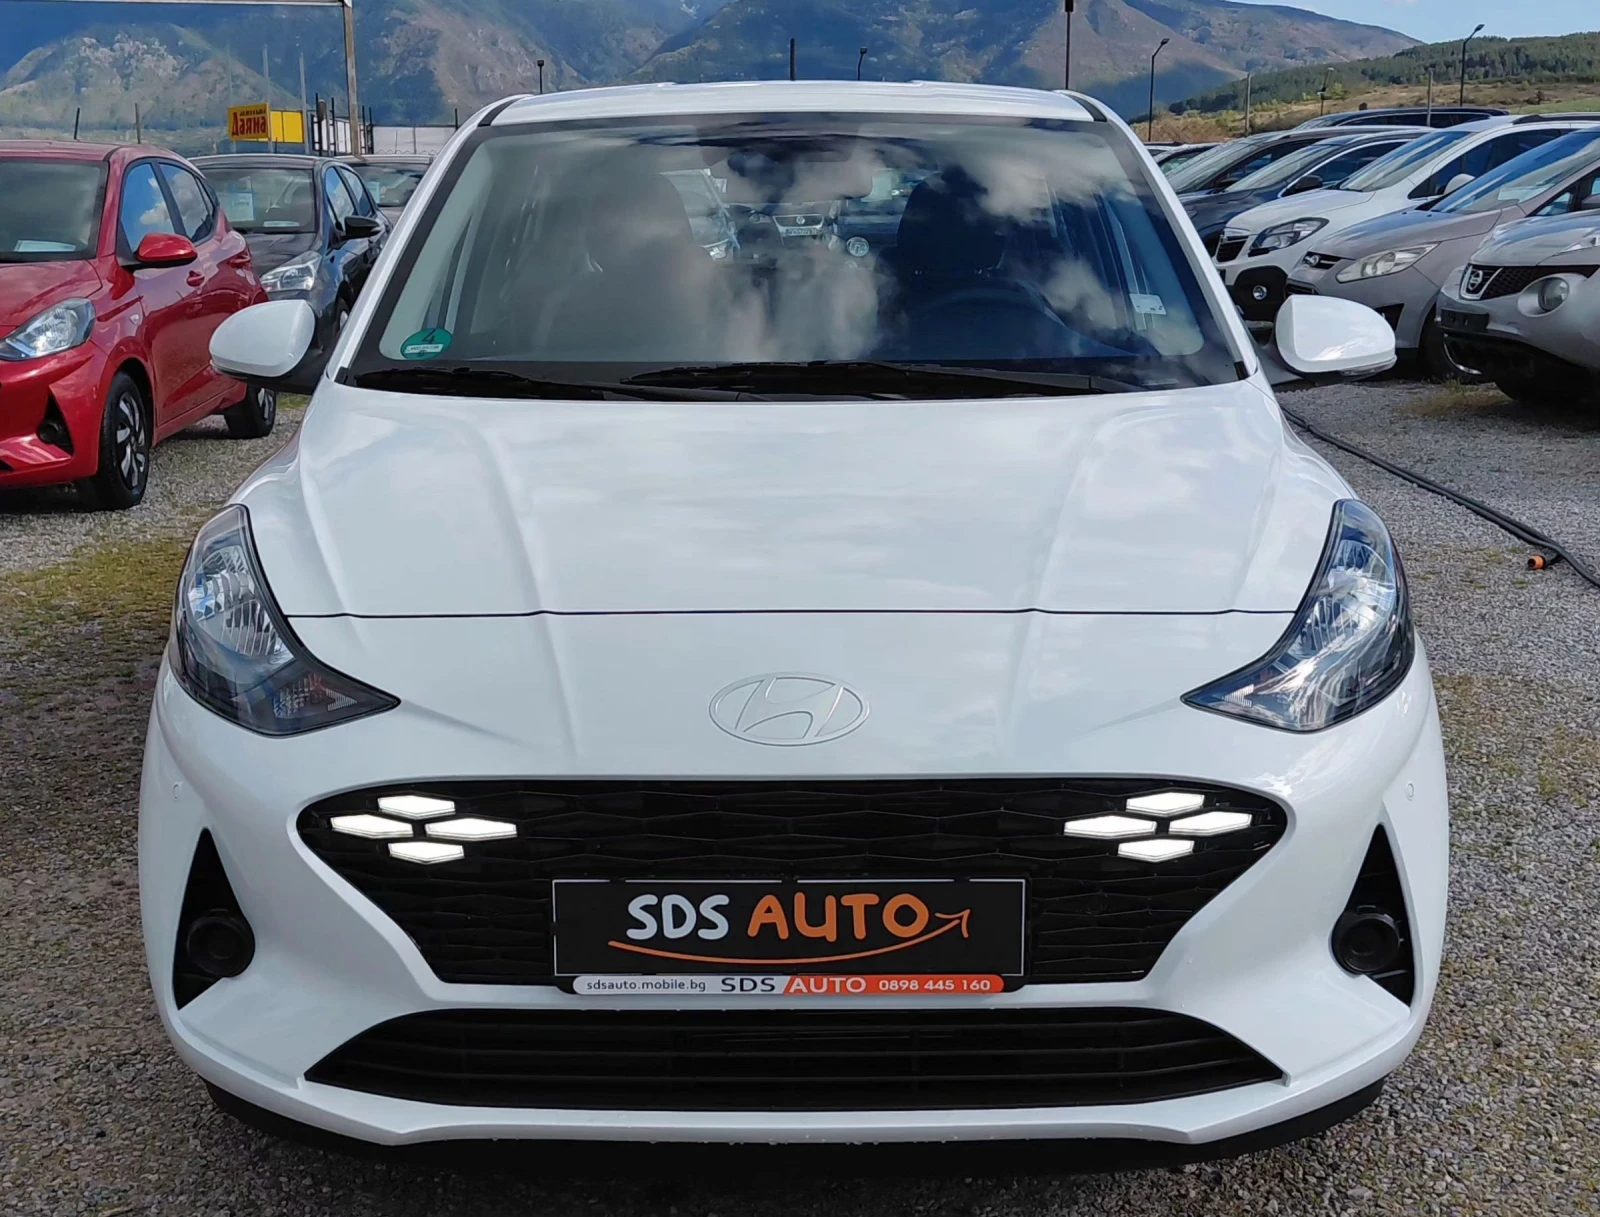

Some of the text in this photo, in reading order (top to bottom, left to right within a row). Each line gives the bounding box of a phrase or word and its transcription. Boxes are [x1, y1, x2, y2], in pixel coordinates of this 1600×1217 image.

[231, 111, 267, 137] Даяна
[421, 329, 437, 345] 4
[626, 892, 930, 943] SDS AUTO
[586, 976, 991, 994] sdsauto.mobile.bg SDS AUTO 0898 445 160
